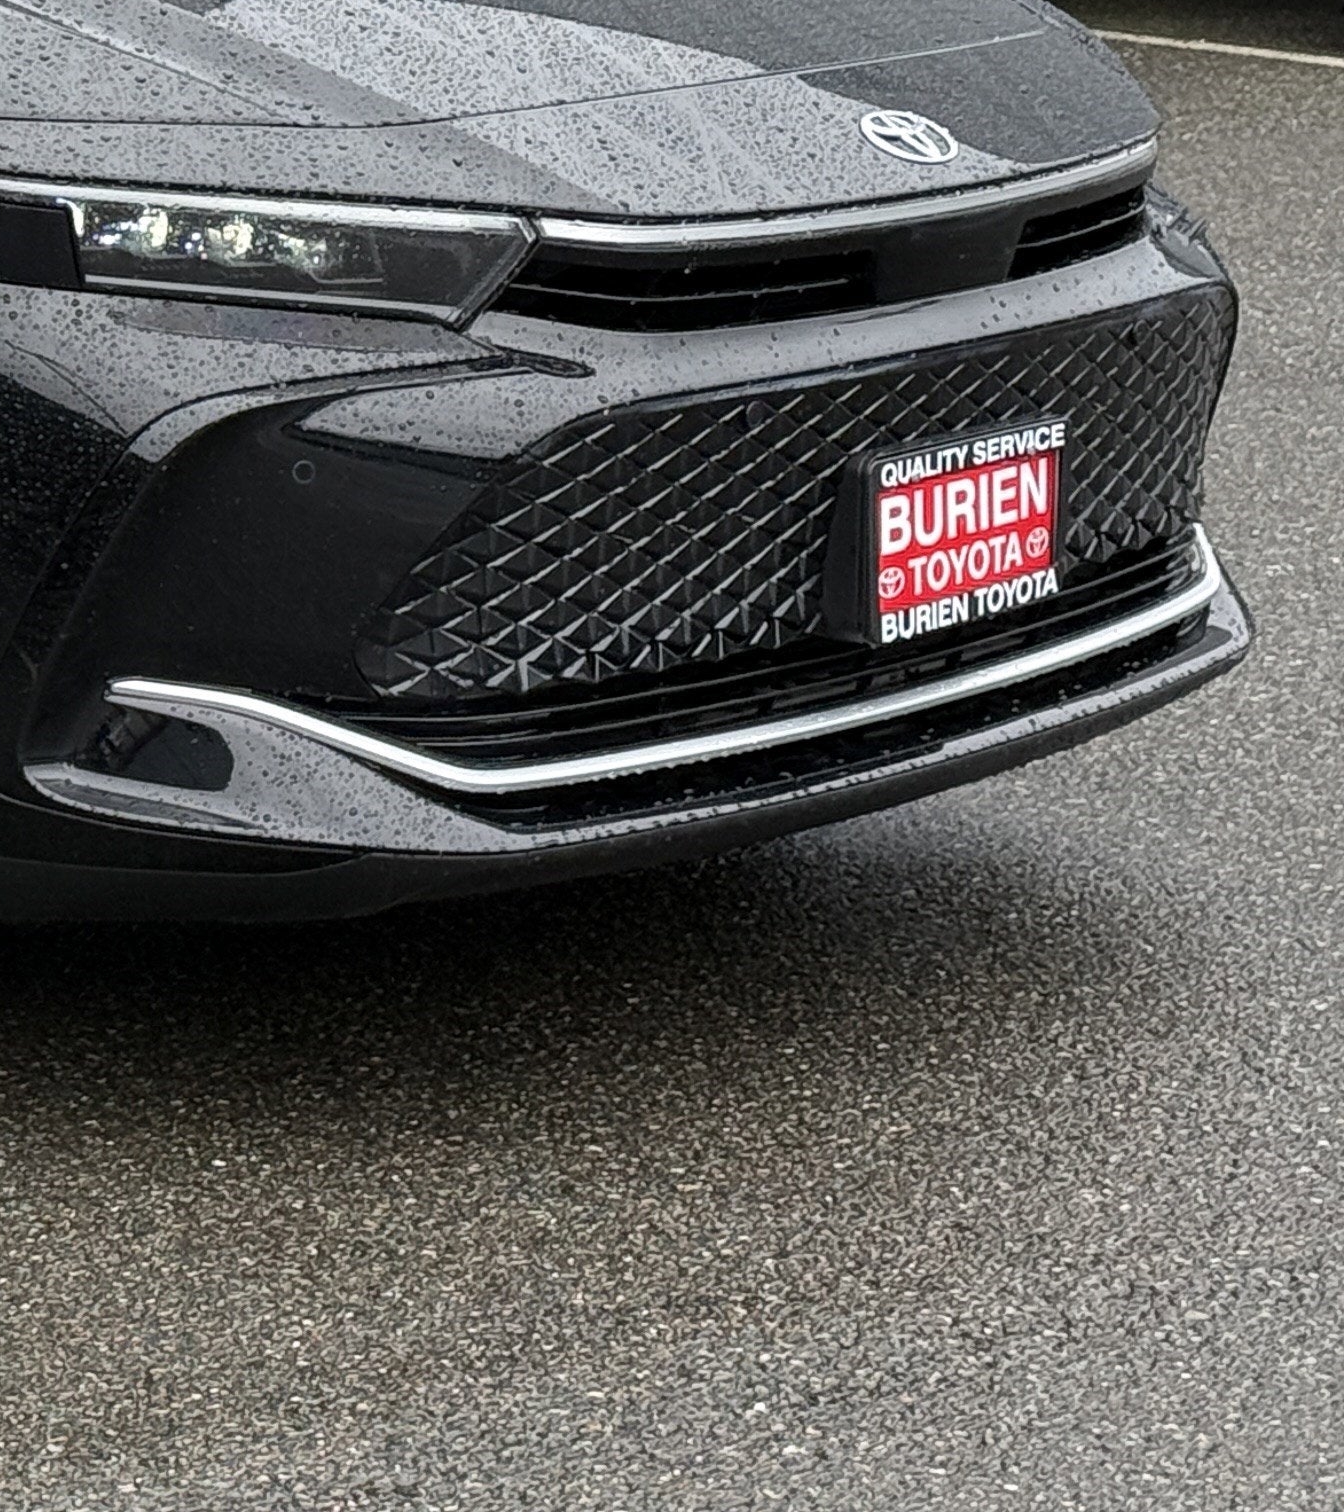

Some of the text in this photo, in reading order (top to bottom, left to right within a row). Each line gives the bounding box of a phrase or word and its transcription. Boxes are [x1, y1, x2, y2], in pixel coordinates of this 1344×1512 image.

[881, 423, 1065, 488] QUALITY SERVICE
[880, 457, 1048, 556] BURIEN
[908, 531, 1024, 596] TOYOTA
[881, 567, 1059, 643] BURIEN TOYOTA
